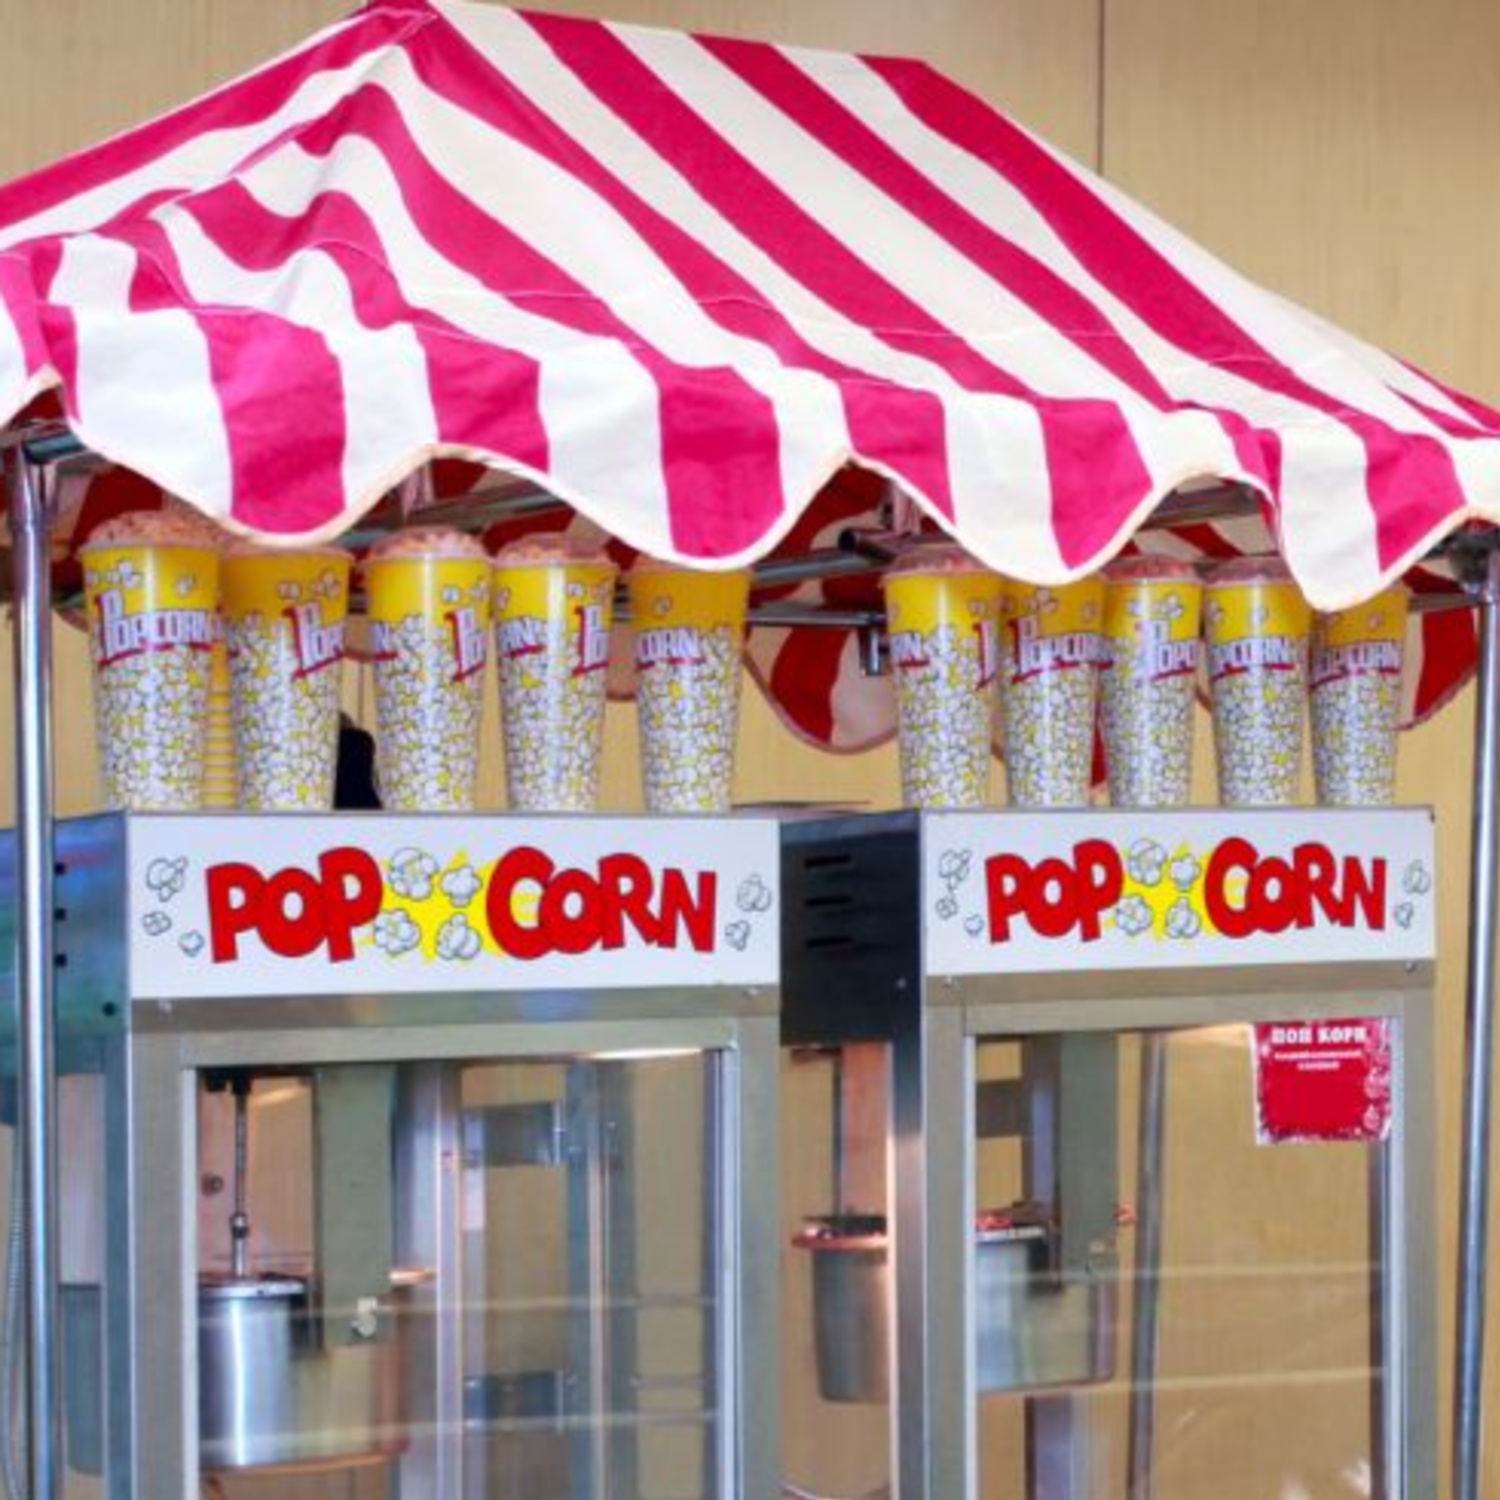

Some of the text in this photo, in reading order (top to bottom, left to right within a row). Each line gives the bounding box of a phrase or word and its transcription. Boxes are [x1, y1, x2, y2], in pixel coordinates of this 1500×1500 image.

[206, 846, 717, 964] POP CORN
[985, 837, 1387, 943] POP CORN
